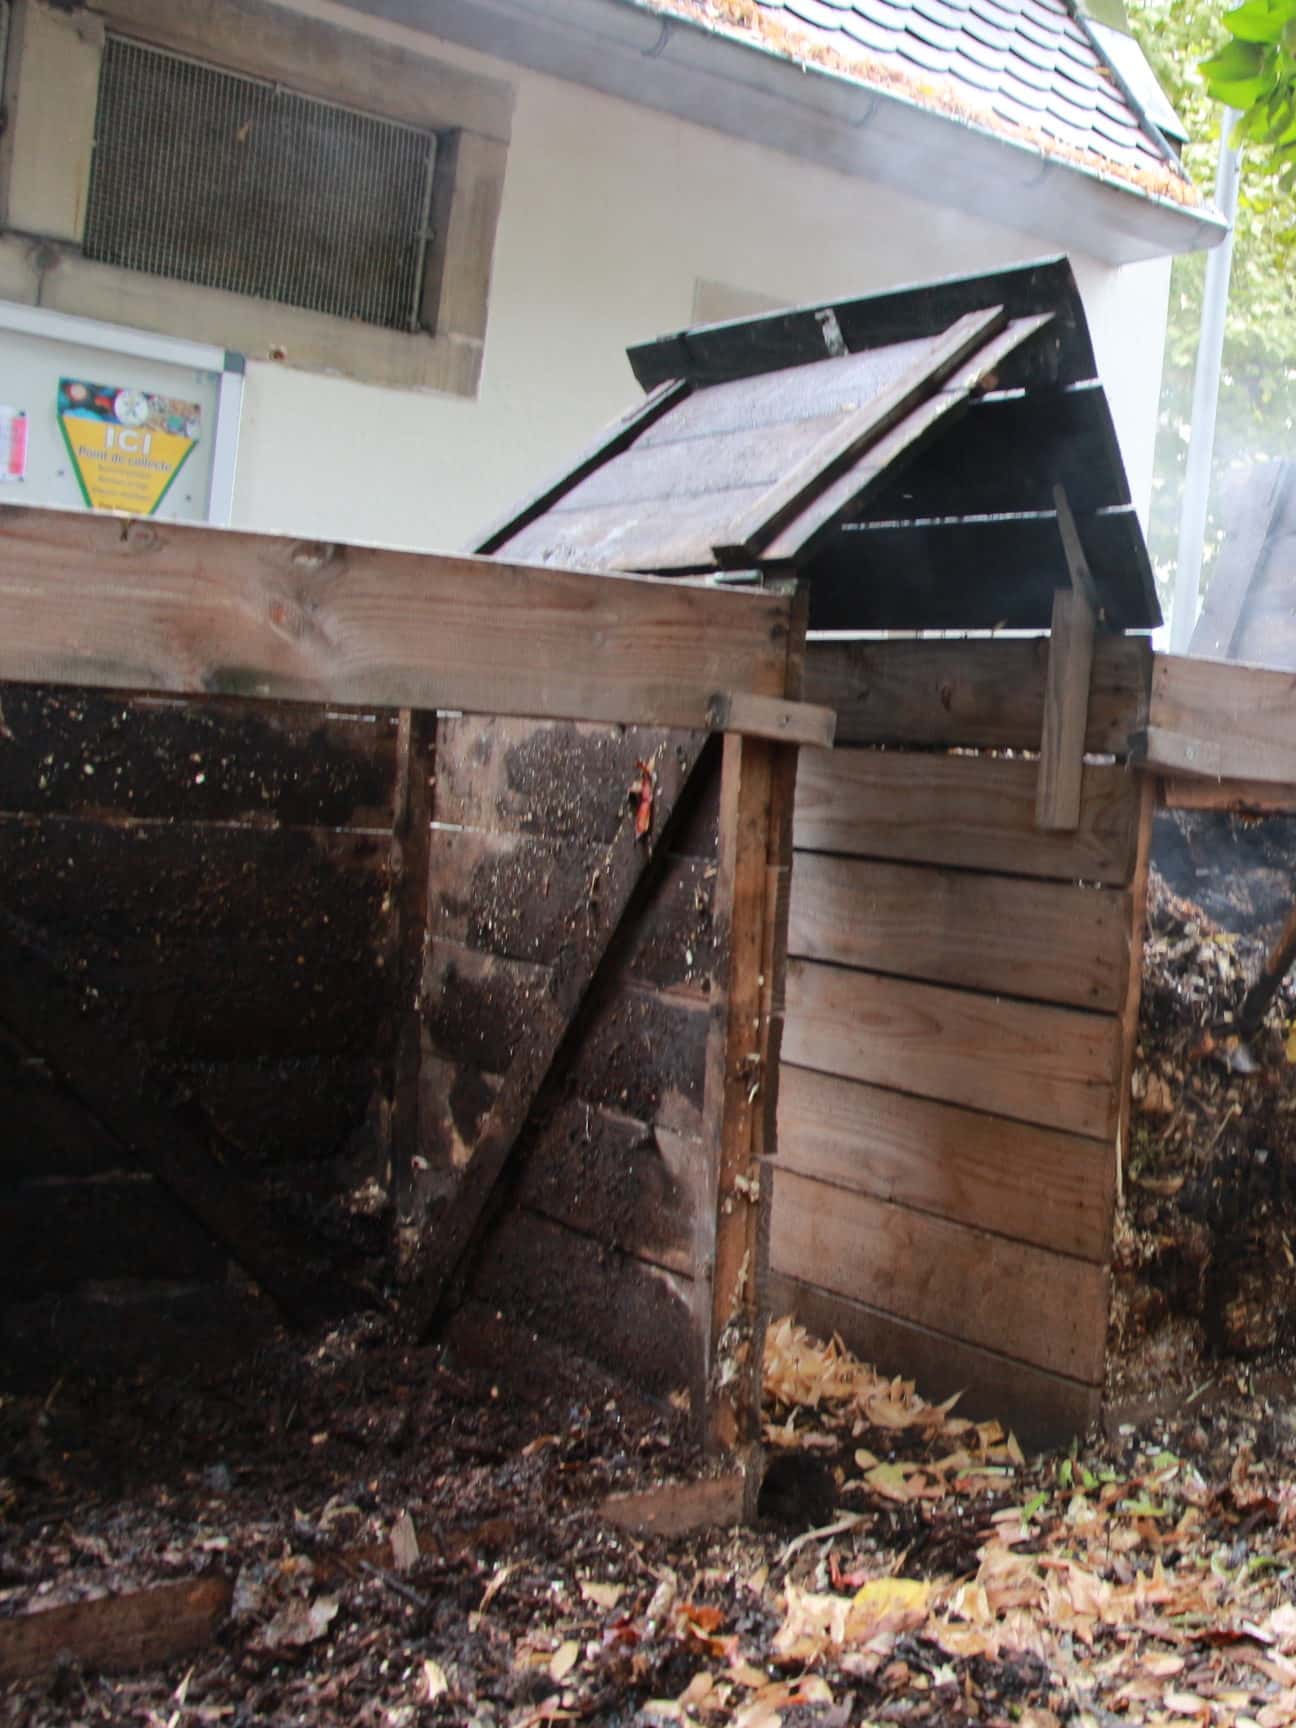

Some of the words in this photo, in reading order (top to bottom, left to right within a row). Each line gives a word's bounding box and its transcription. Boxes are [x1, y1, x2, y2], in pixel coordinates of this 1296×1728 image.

[106, 427, 151, 455] ICI
[79, 446, 107, 461] Point
[112, 453, 124, 464] de
[128, 456, 171, 472] collecte
